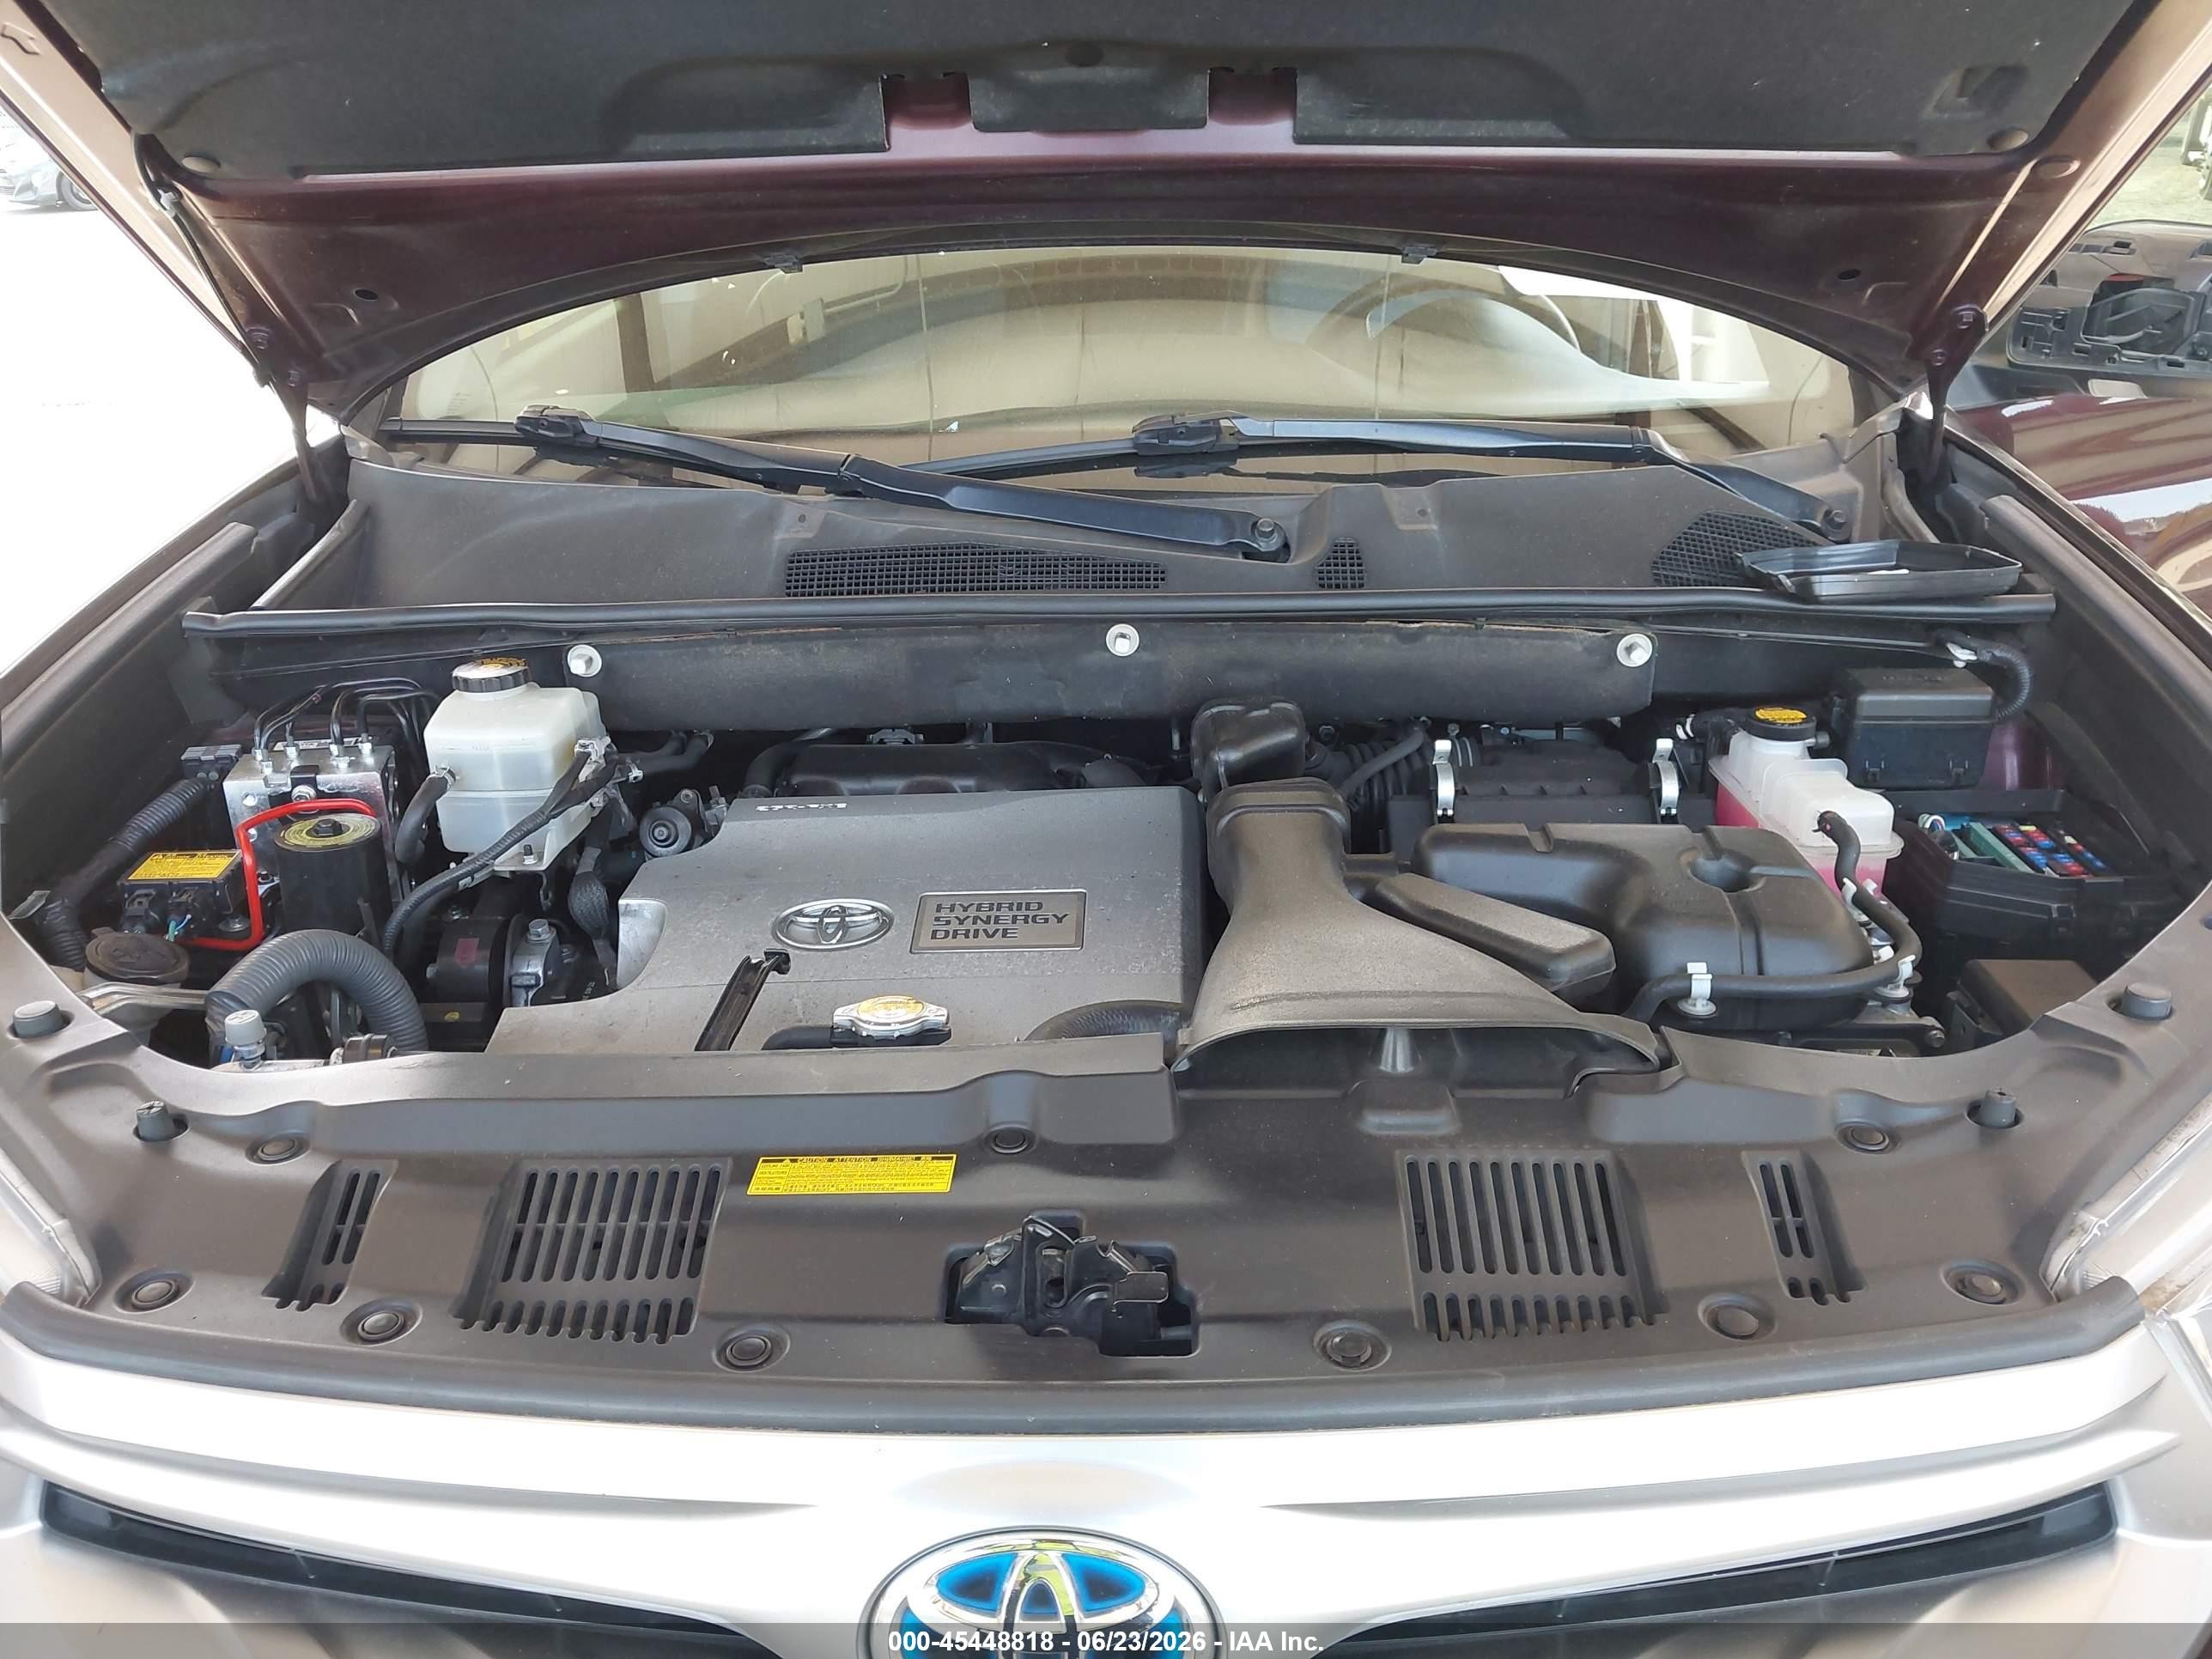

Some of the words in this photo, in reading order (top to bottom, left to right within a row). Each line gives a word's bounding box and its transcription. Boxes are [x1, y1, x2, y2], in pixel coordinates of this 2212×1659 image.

[935, 902, 1043, 913] HYBRID
[933, 913, 1071, 927] SYNERGY
[930, 927, 1019, 940] DRIVE
